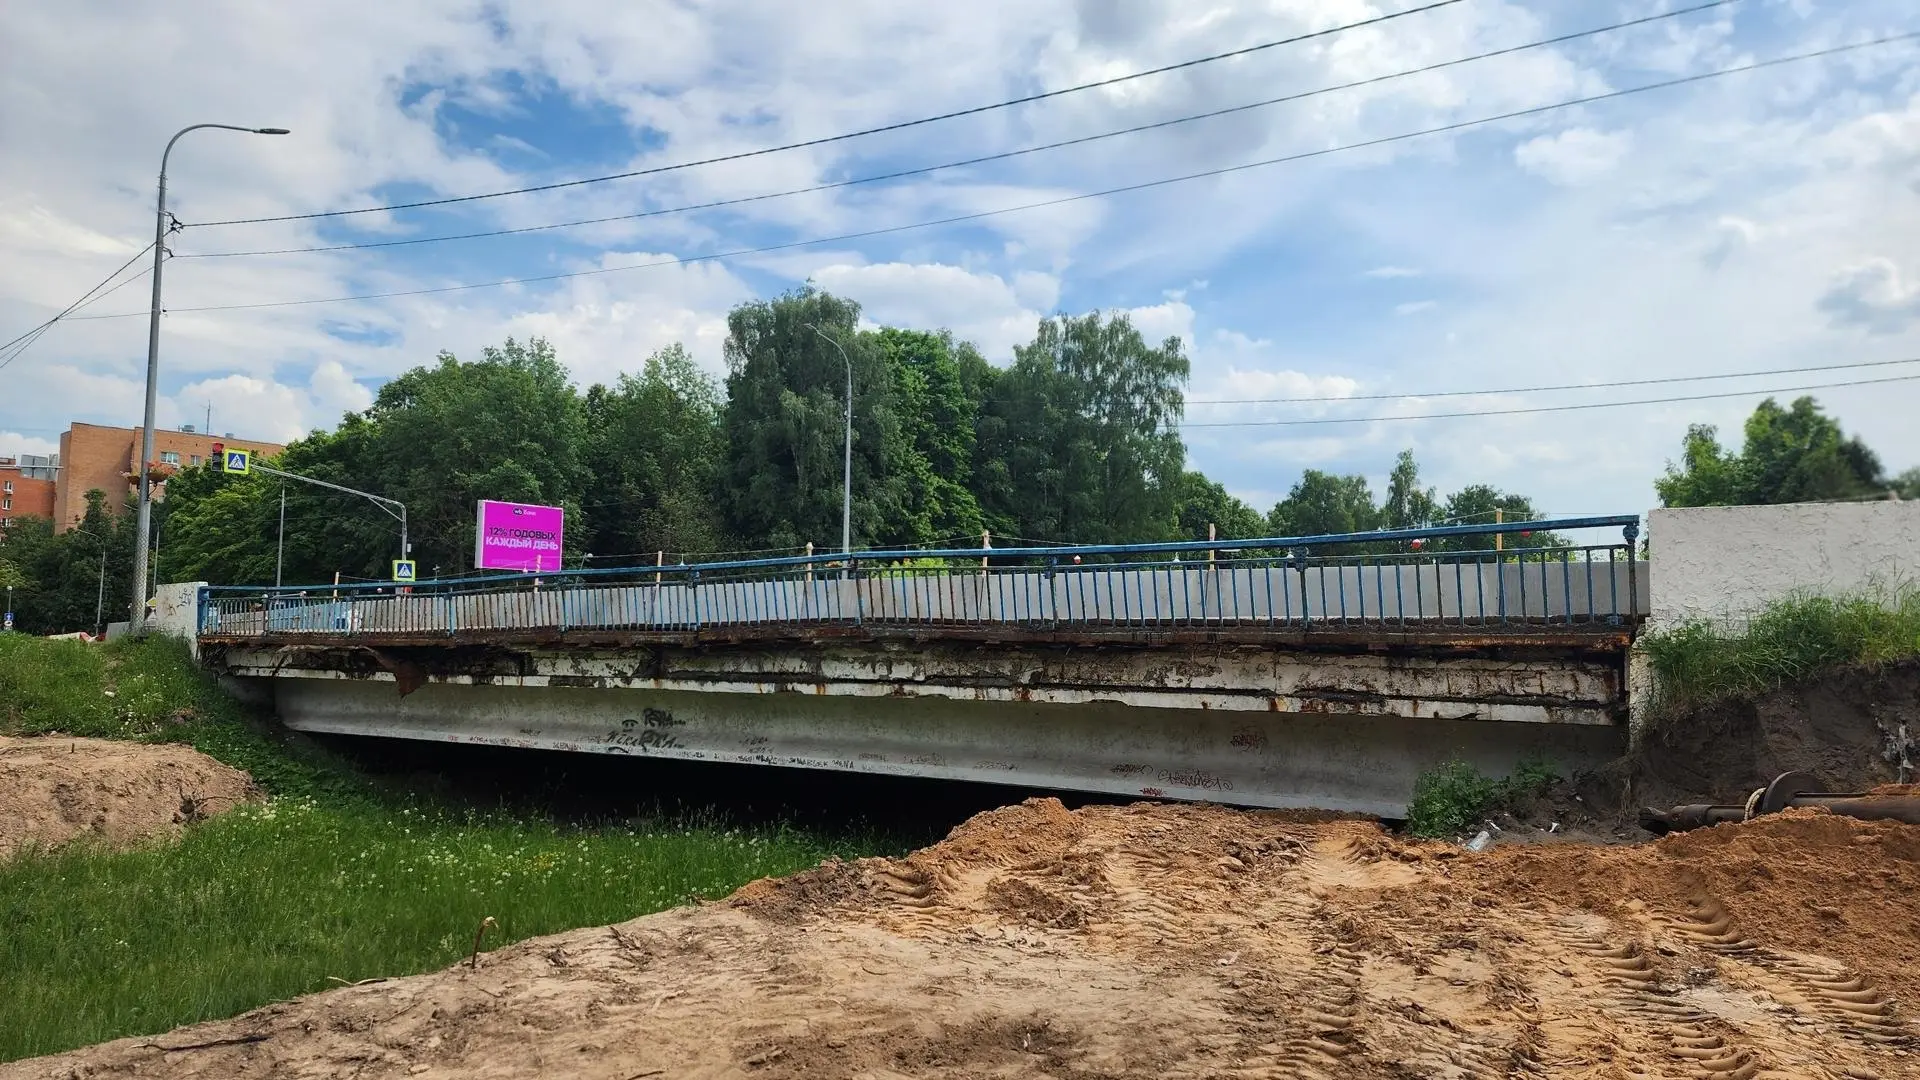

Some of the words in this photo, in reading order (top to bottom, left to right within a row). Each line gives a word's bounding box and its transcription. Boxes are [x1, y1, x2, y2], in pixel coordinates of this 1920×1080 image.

[490, 528, 507, 537] 12%
[509, 529, 556, 540] ГОДОВЫХ
[486, 537, 532, 549] КАЖДЫЙ
[533, 540, 559, 550] ДЕНЬ
